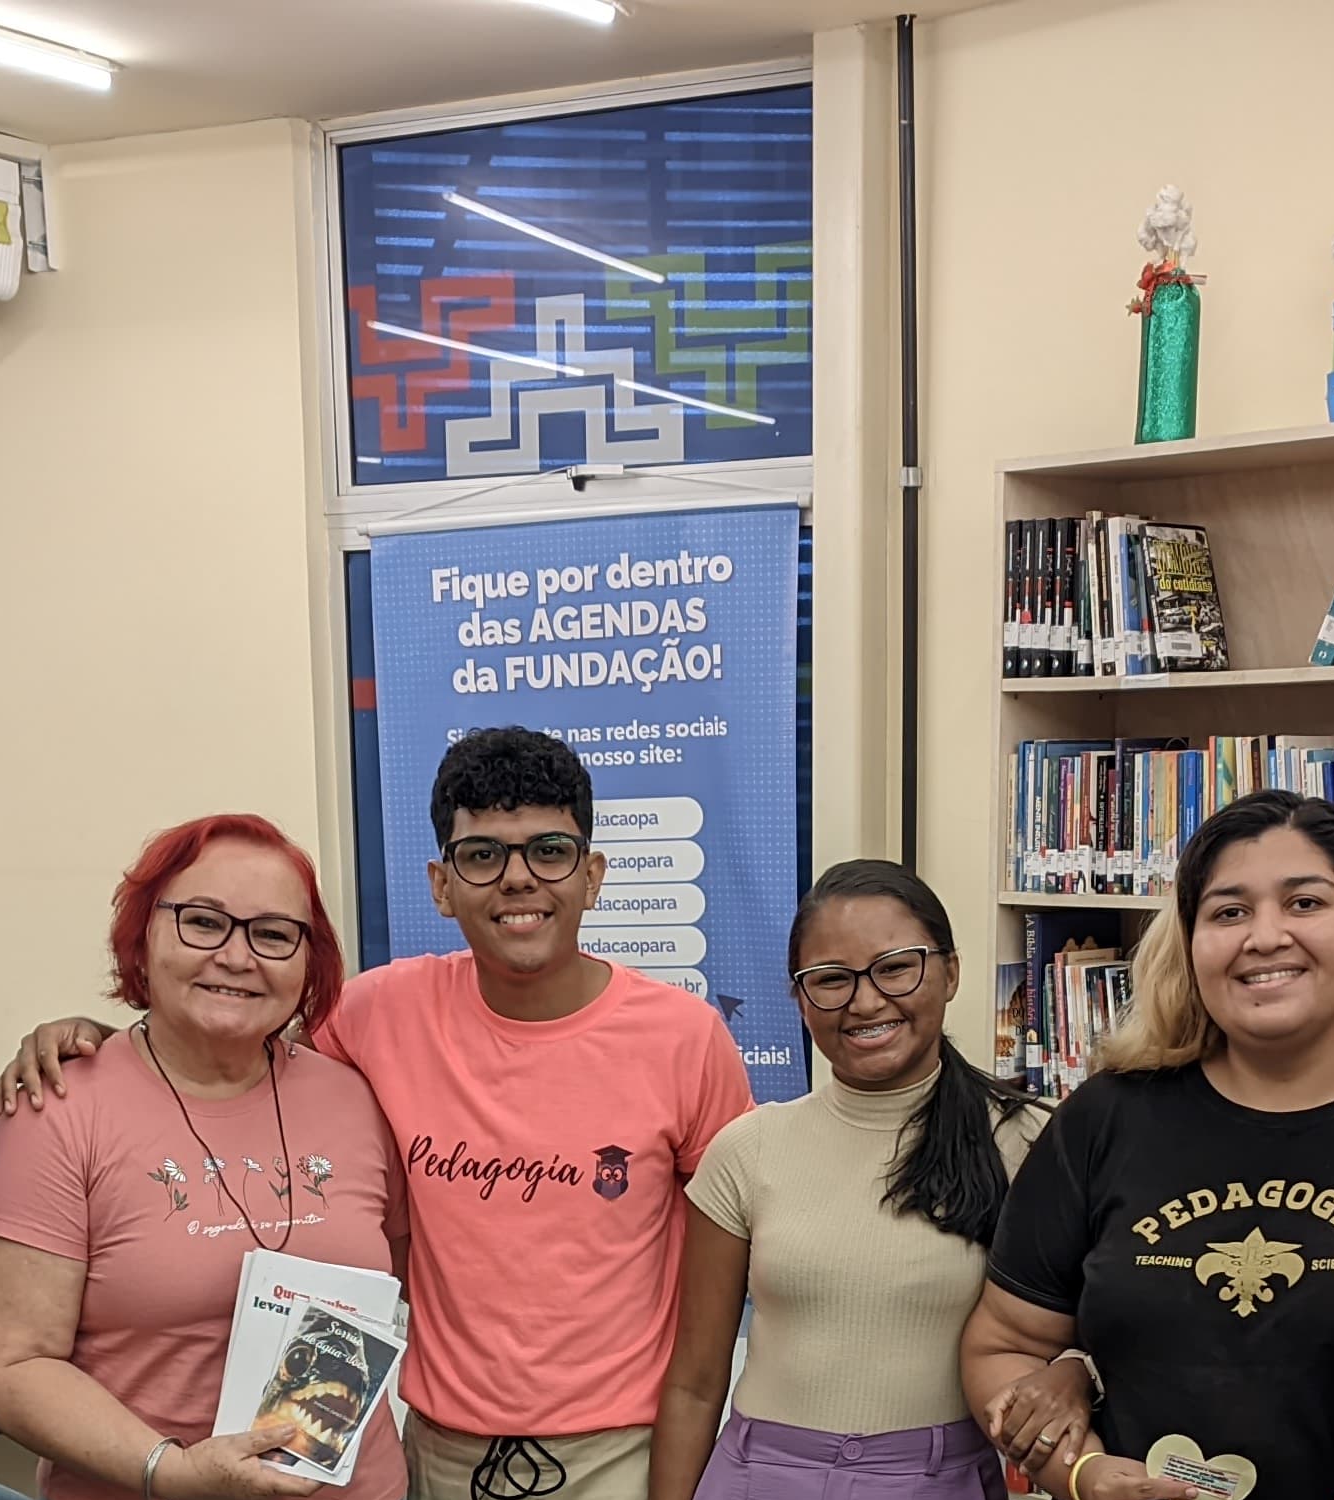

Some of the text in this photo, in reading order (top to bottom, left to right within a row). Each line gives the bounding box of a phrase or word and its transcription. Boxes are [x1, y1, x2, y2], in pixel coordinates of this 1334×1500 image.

[431, 550, 733, 609] Fique por dentro
[1160, 576, 1172, 591] do
[458, 597, 707, 647] das AGENDAS
[452, 637, 723, 694] da FUNDAÇÃO!
[567, 726, 602, 743] nas
[606, 719, 661, 741] redes
[665, 715, 727, 738] sociais
[577, 743, 683, 767] nosso site:
[1026, 929, 1036, 959] Bíblia
[407, 1134, 584, 1203] Pedagogia
[1135, 1255, 1193, 1269] TEACHING
